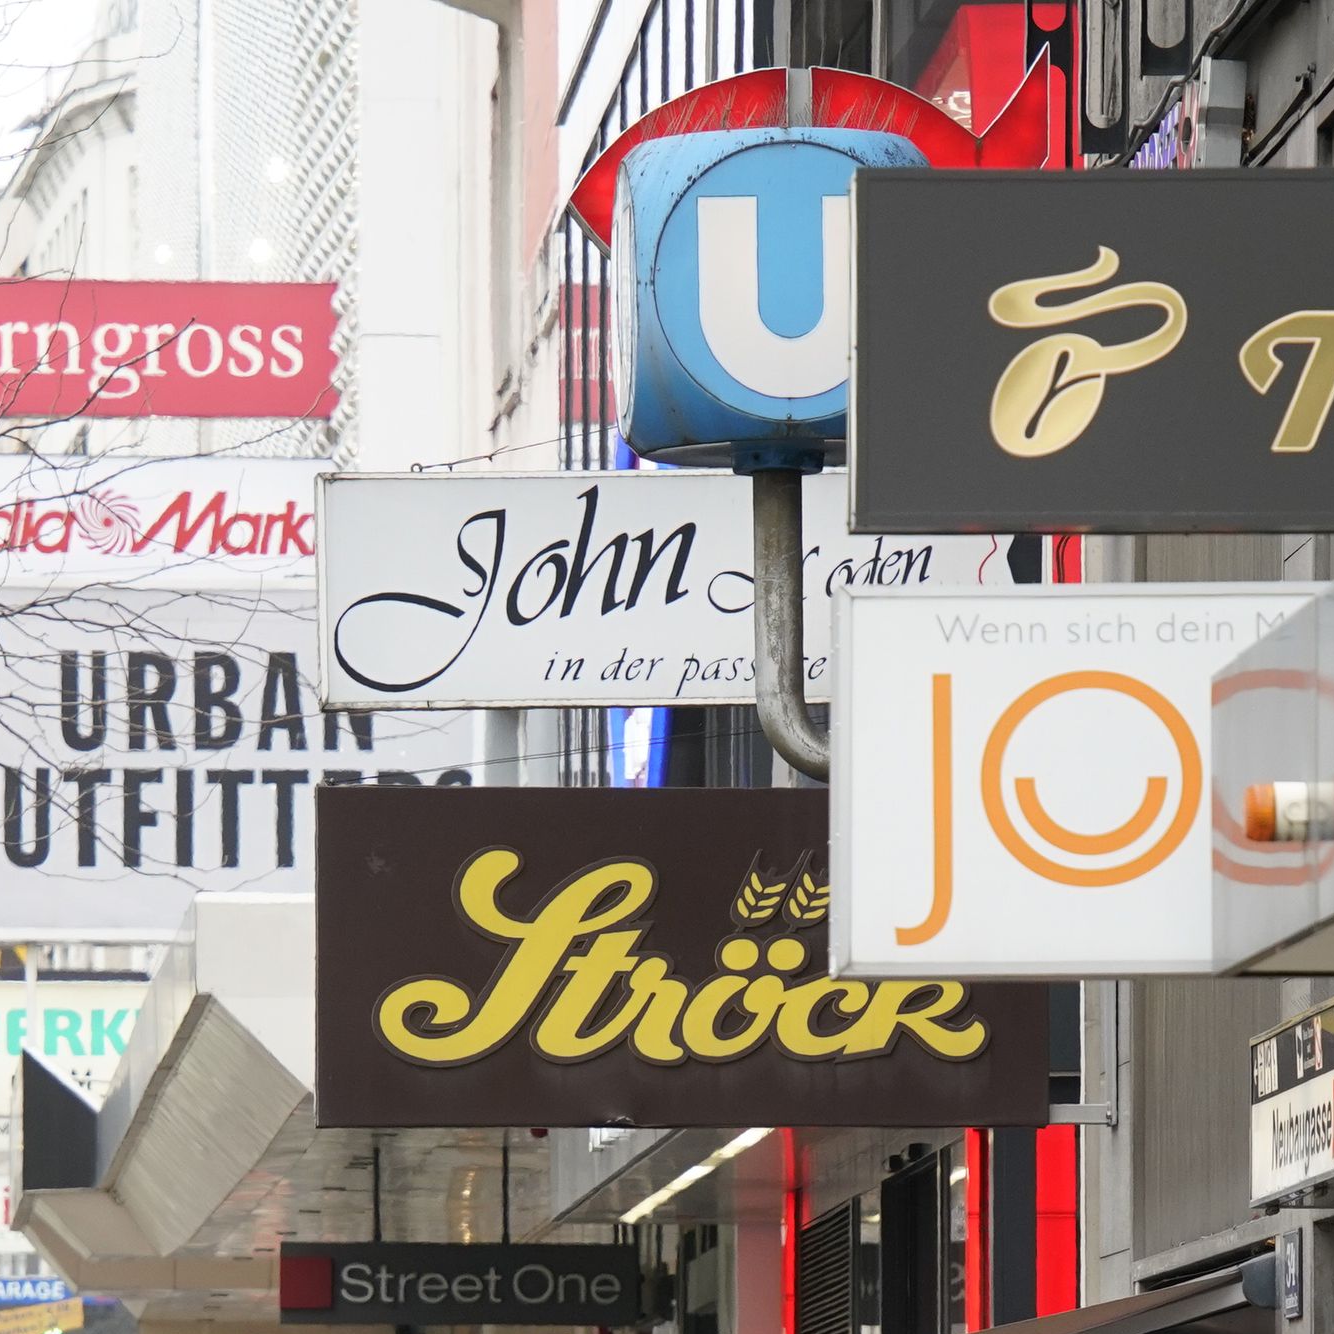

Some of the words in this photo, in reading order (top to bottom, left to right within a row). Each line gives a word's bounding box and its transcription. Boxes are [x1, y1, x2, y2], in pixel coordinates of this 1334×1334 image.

[697, 195, 849, 398] U
[131, 490, 315, 557] Mark
[334, 485, 697, 692] John
[707, 537, 932, 613] oden
[937, 612, 1047, 644] Wenn
[1066, 612, 1136, 644] sich
[1156, 612, 1235, 644] dein
[544, 651, 585, 682] in
[601, 647, 664, 682] der
[675, 651, 825, 697] passe
[377, 848, 987, 1062] Ströck
[1272, 1102, 1331, 1174] Neubaugasse
[340, 1263, 503, 1304] Street
[512, 1264, 621, 1304] One
[1285, 1242, 1297, 1289] 34
